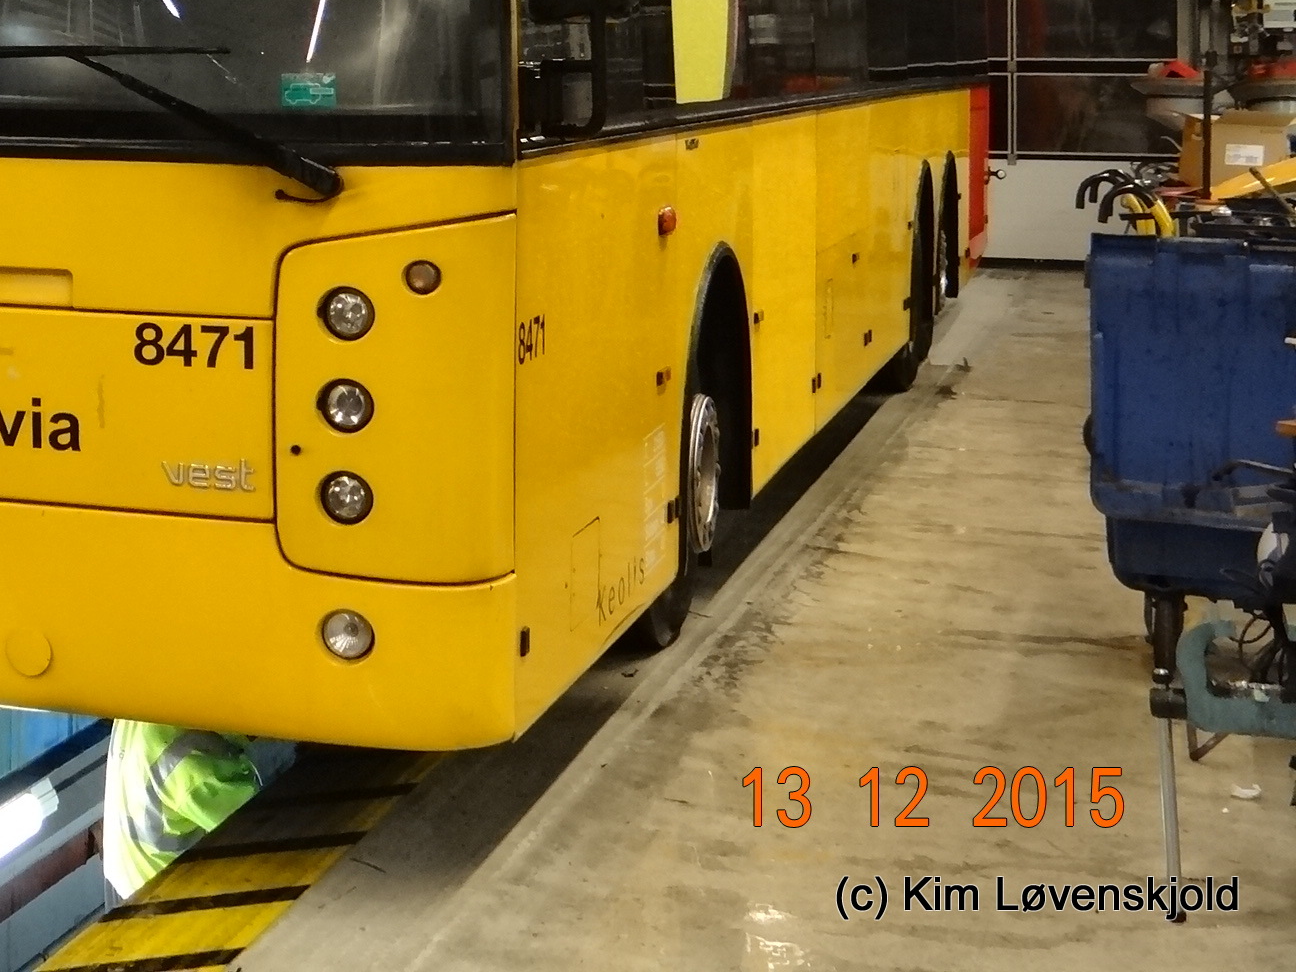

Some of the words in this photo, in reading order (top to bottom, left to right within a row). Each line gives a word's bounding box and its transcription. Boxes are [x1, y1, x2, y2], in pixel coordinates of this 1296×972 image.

[134, 322, 254, 370] 8471
[518, 313, 545, 365] 8471
[161, 458, 255, 492] vest
[595, 555, 645, 627] Keolis
